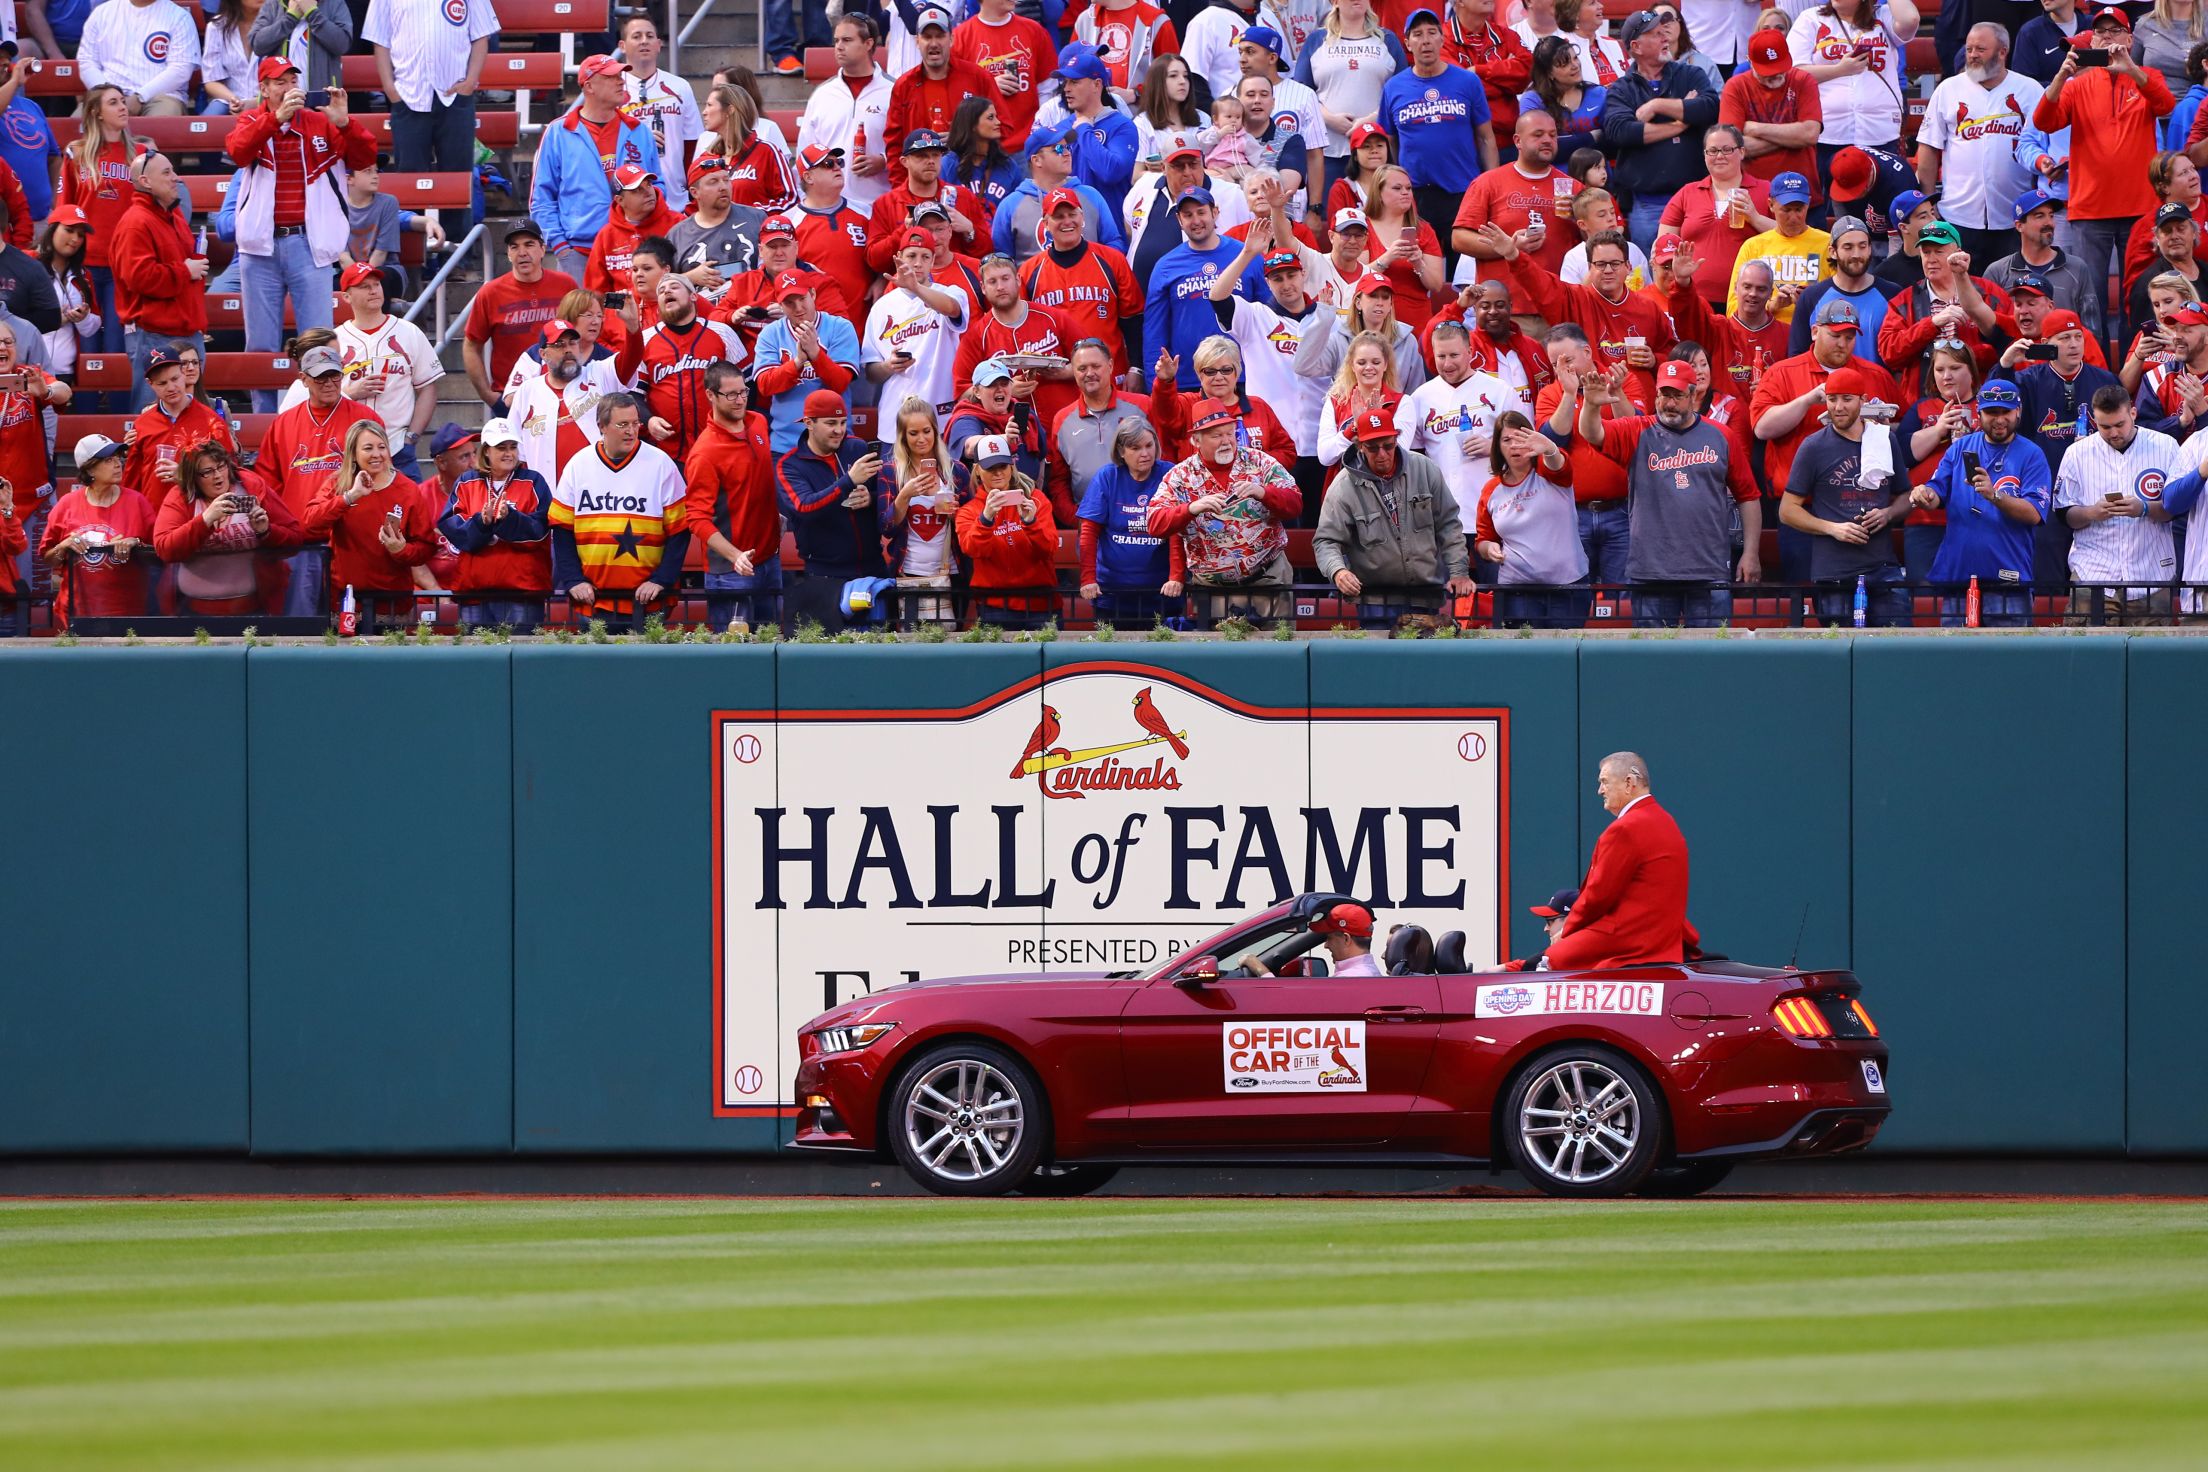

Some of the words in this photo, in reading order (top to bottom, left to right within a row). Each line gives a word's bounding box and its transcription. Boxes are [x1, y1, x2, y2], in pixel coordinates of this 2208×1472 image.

[1328, 46, 1381, 56] CARDINALS
[58, 66, 69, 75] 14
[512, 60, 523, 69] 19
[1399, 103, 1466, 123] CHAMPIONS
[1913, 106, 1923, 114] 13
[194, 122, 204, 132] 15
[100, 161, 133, 184] LOU
[419, 180, 430, 189] 17
[1177, 278, 1243, 297] CHAMPS
[227, 300, 237, 309] 14
[504, 307, 558, 325] CARDINA
[89, 361, 100, 370] 12
[276, 359, 287, 368] 14
[654, 353, 718, 385] Cardina
[1431, 410, 1483, 435] Cardils
[1648, 445, 1719, 471] Cardinals
[1829, 454, 1858, 487] SAINT
[2140, 474, 2165, 498] CUBS
[577, 489, 647, 513] Astros
[1122, 505, 1145, 513] CHICAGO
[912, 513, 943, 526] STL
[1128, 519, 1147, 527] WOR
[1112, 534, 1162, 546] CHAMPION
[1300, 606, 1311, 615] 10
[1598, 607, 1608, 616] 13
[1038, 747, 1184, 800] Cardinals
[754, 804, 1057, 910] HALL
[1070, 812, 1147, 910] of
[1163, 804, 1467, 911] FAME
[1008, 939, 1157, 963] PRESENTED
[1483, 993, 1518, 1005] OPENING
[1518, 992, 1535, 1003] DAY
[1544, 982, 1655, 1014] HERZOG
[1228, 1027, 1360, 1050] OFFICIAL
[1230, 1050, 1290, 1073] CAR
[1294, 1057, 1303, 1068] OF
[1306, 1055, 1320, 1067] THE
[1235, 1078, 1254, 1087] Ford
[1261, 1079, 1311, 1087] BuyFordNow.com
[1318, 1071, 1362, 1087] Cardinals
